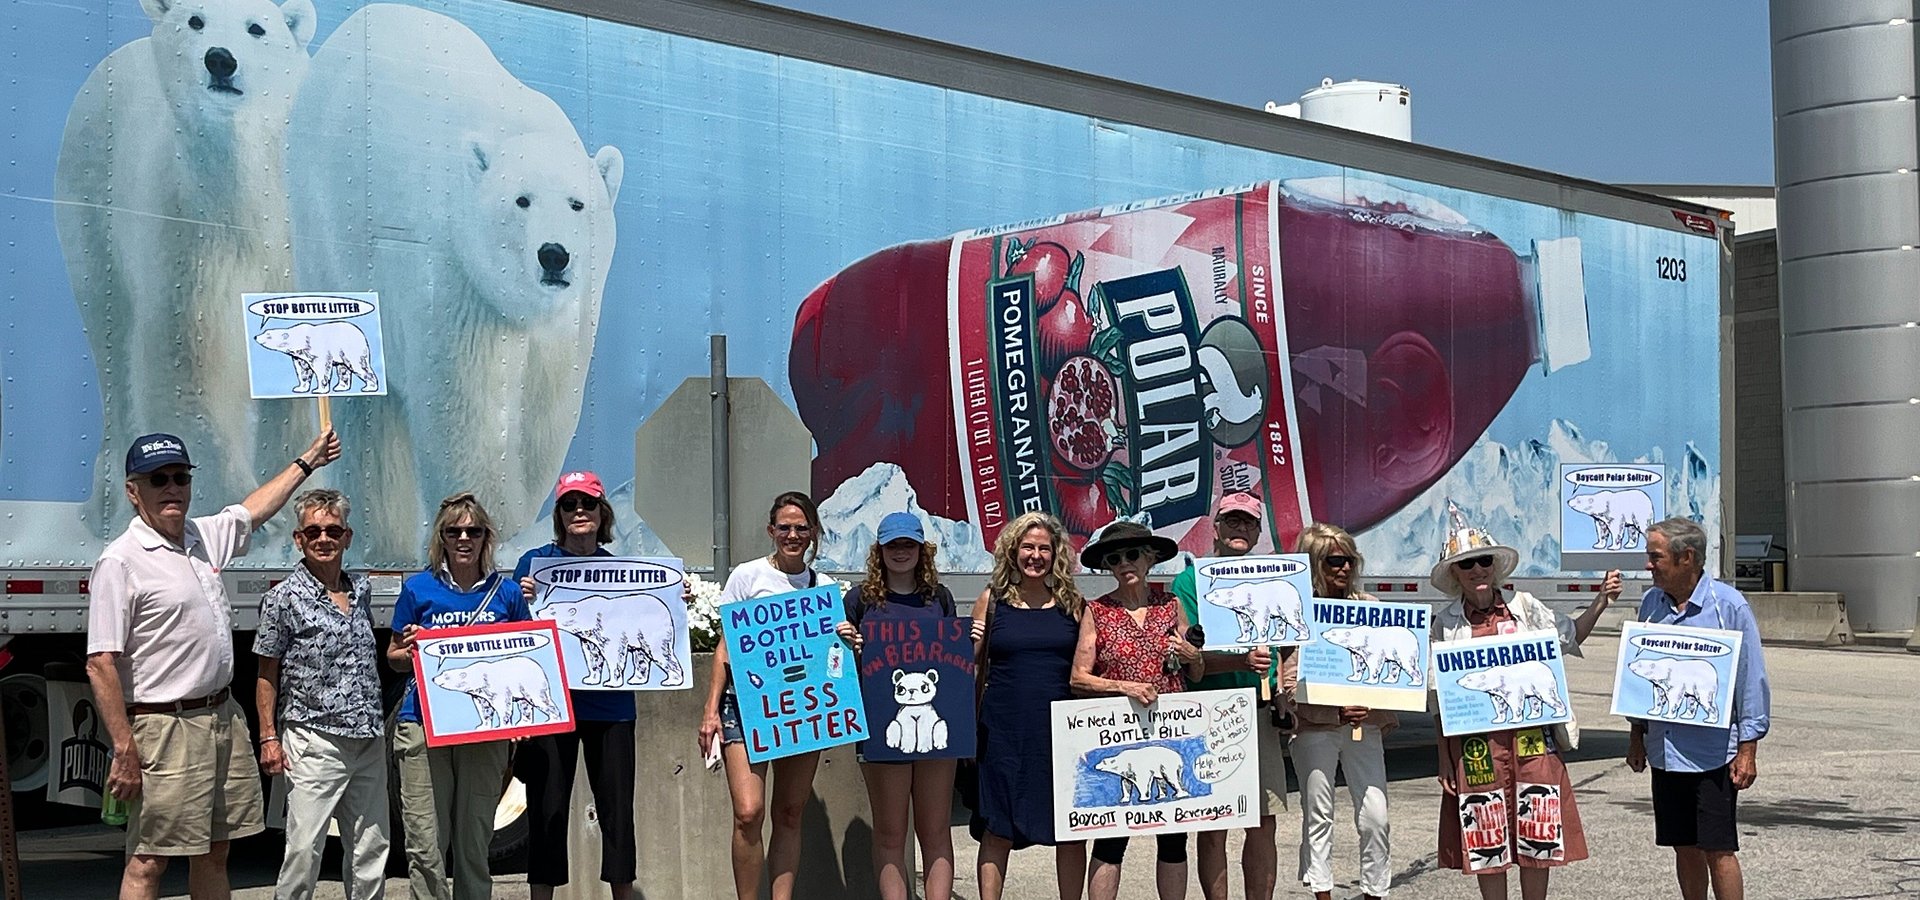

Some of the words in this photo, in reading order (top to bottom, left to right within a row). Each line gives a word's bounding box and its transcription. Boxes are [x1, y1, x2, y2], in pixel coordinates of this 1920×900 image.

[1212, 246, 1228, 304] NATURALLY
[1656, 256, 1686, 282] 1203
[263, 303, 289, 314] STOP
[291, 302, 327, 313] BOTTLE
[328, 302, 360, 313] LITTER
[967, 358, 983, 366] 1
[1252, 265, 1269, 324] SINCE
[1268, 421, 1285, 465] 1882
[968, 369, 987, 408] LITER
[1003, 289, 1042, 515] POMEGRANATE
[1115, 290, 1200, 510] POLAR
[970, 410, 989, 424] (1
[1576, 473, 1605, 482] Boycott
[1606, 473, 1625, 481] Polar
[1627, 473, 1652, 482] Seltzer
[550, 570, 582, 583] STOP
[584, 569, 627, 583] BOTTLE
[629, 569, 667, 583] LITTER
[1210, 567, 1239, 576] Update
[1241, 565, 1254, 574] the
[1256, 564, 1280, 573] Bottle
[1282, 563, 1296, 572] Bill
[431, 611, 496, 625] MOTHERS
[731, 591, 833, 630] MODERN
[739, 616, 835, 654] BOTTLE
[864, 620, 921, 642] THIS
[937, 620, 963, 641] IS
[439, 643, 463, 656] STOP
[467, 639, 502, 653] BOTTLE
[503, 636, 536, 649] LITTER
[1641, 637, 1670, 648] Boycott
[1672, 640, 1692, 650] Polar
[1694, 642, 1722, 653] Seltzer
[765, 644, 813, 669] BILL
[1436, 640, 1557, 673] UNBEARABLE
[762, 682, 839, 719] LESS
[1067, 715, 1084, 730] We
[1088, 711, 1115, 729] Need
[1123, 712, 1140, 724] an
[1148, 703, 1203, 726] Improved
[752, 708, 863, 753] LITTER
[1099, 727, 1151, 746] BOTTLE
[1159, 725, 1191, 739] BILL
[1210, 736, 1225, 750] and
[63, 744, 105, 788] POLAR
[1218, 752, 1245, 764] reduce
[1467, 759, 1490, 772] TELL
[1466, 772, 1495, 785] TRUTH
[1068, 811, 1117, 828] BOYCOTT
[1125, 810, 1167, 825] POLAR
[1174, 804, 1233, 822] Beverages
[1466, 829, 1504, 849] KILLS
[1518, 820, 1556, 841] KILLS
